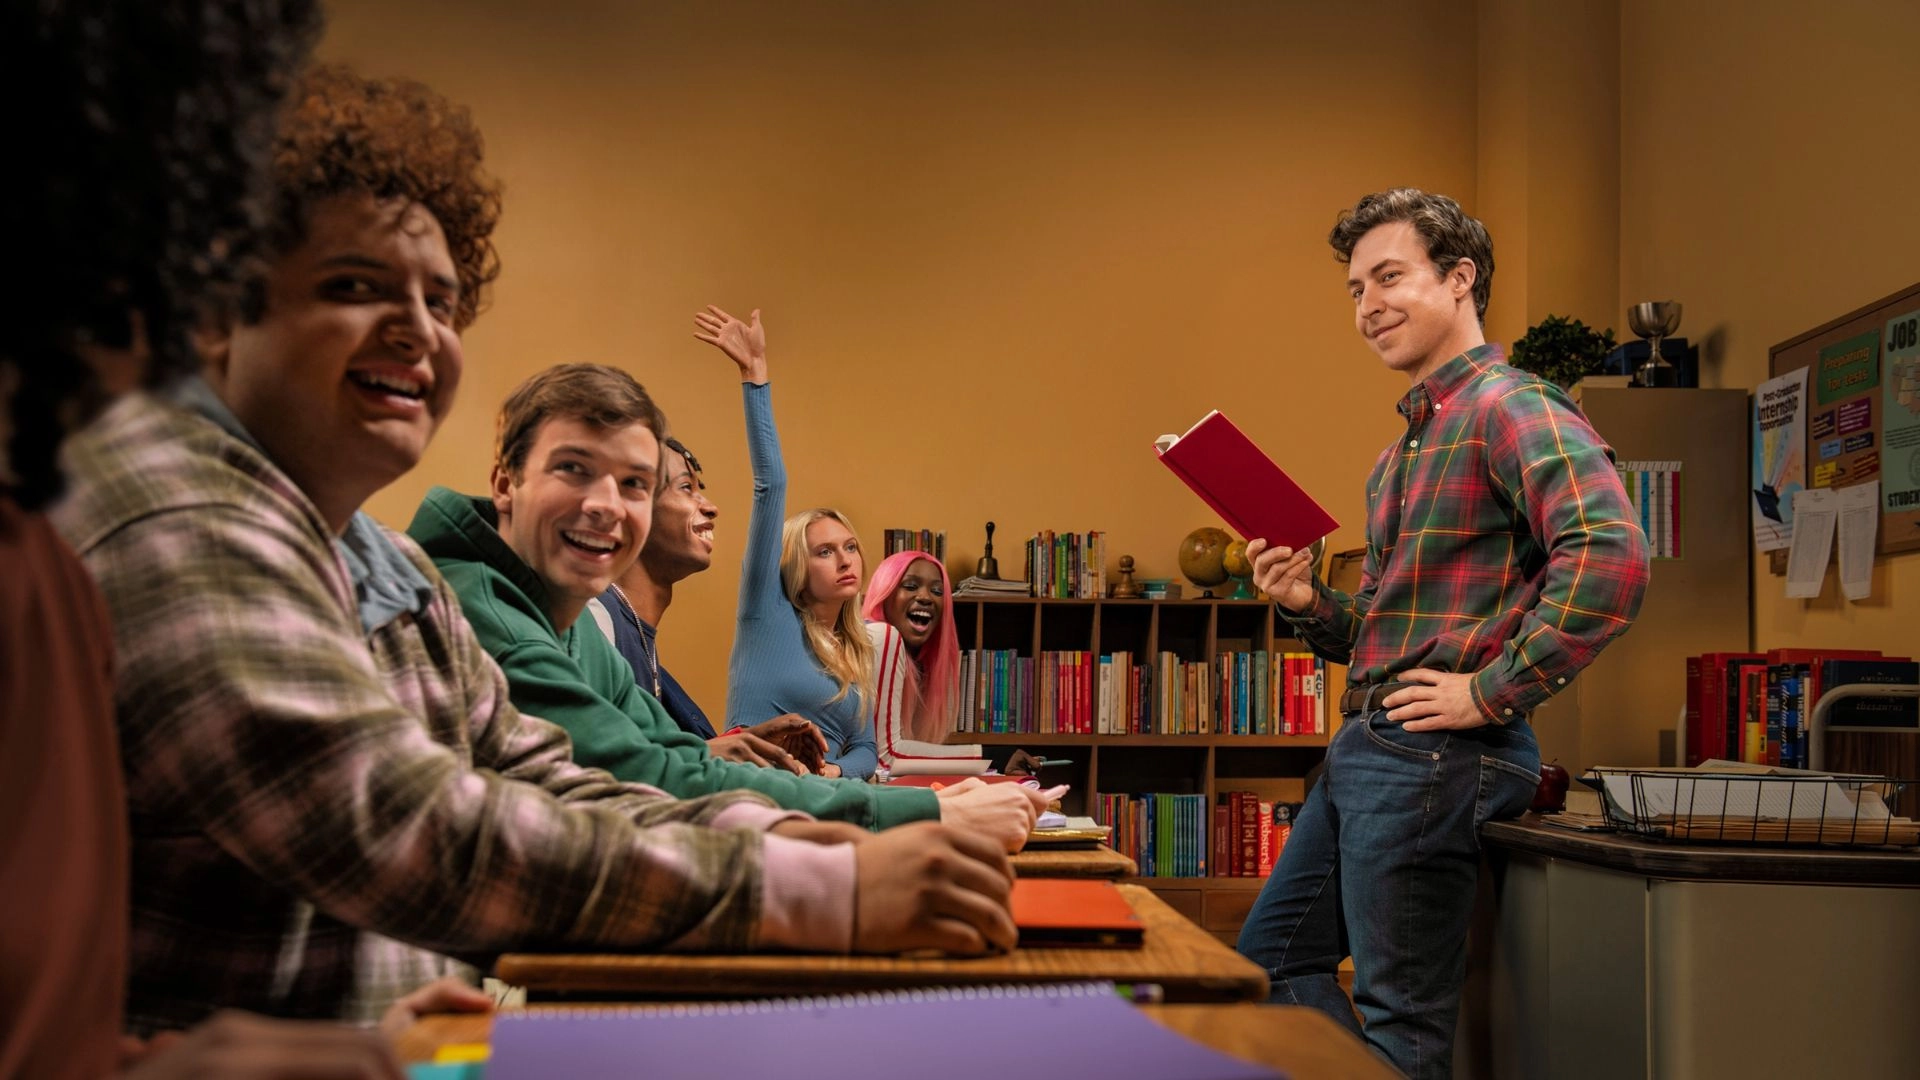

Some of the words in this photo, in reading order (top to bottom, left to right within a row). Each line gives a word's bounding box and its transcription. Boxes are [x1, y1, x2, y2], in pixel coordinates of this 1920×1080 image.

[1887, 318, 1918, 353] JOB
[1824, 347, 1871, 371] Preparing
[1757, 395, 1799, 422] Internship
[1888, 489, 1920, 508] STUDEN
[1315, 673, 1323, 700] ACT
[1260, 815, 1272, 865] Webster's
